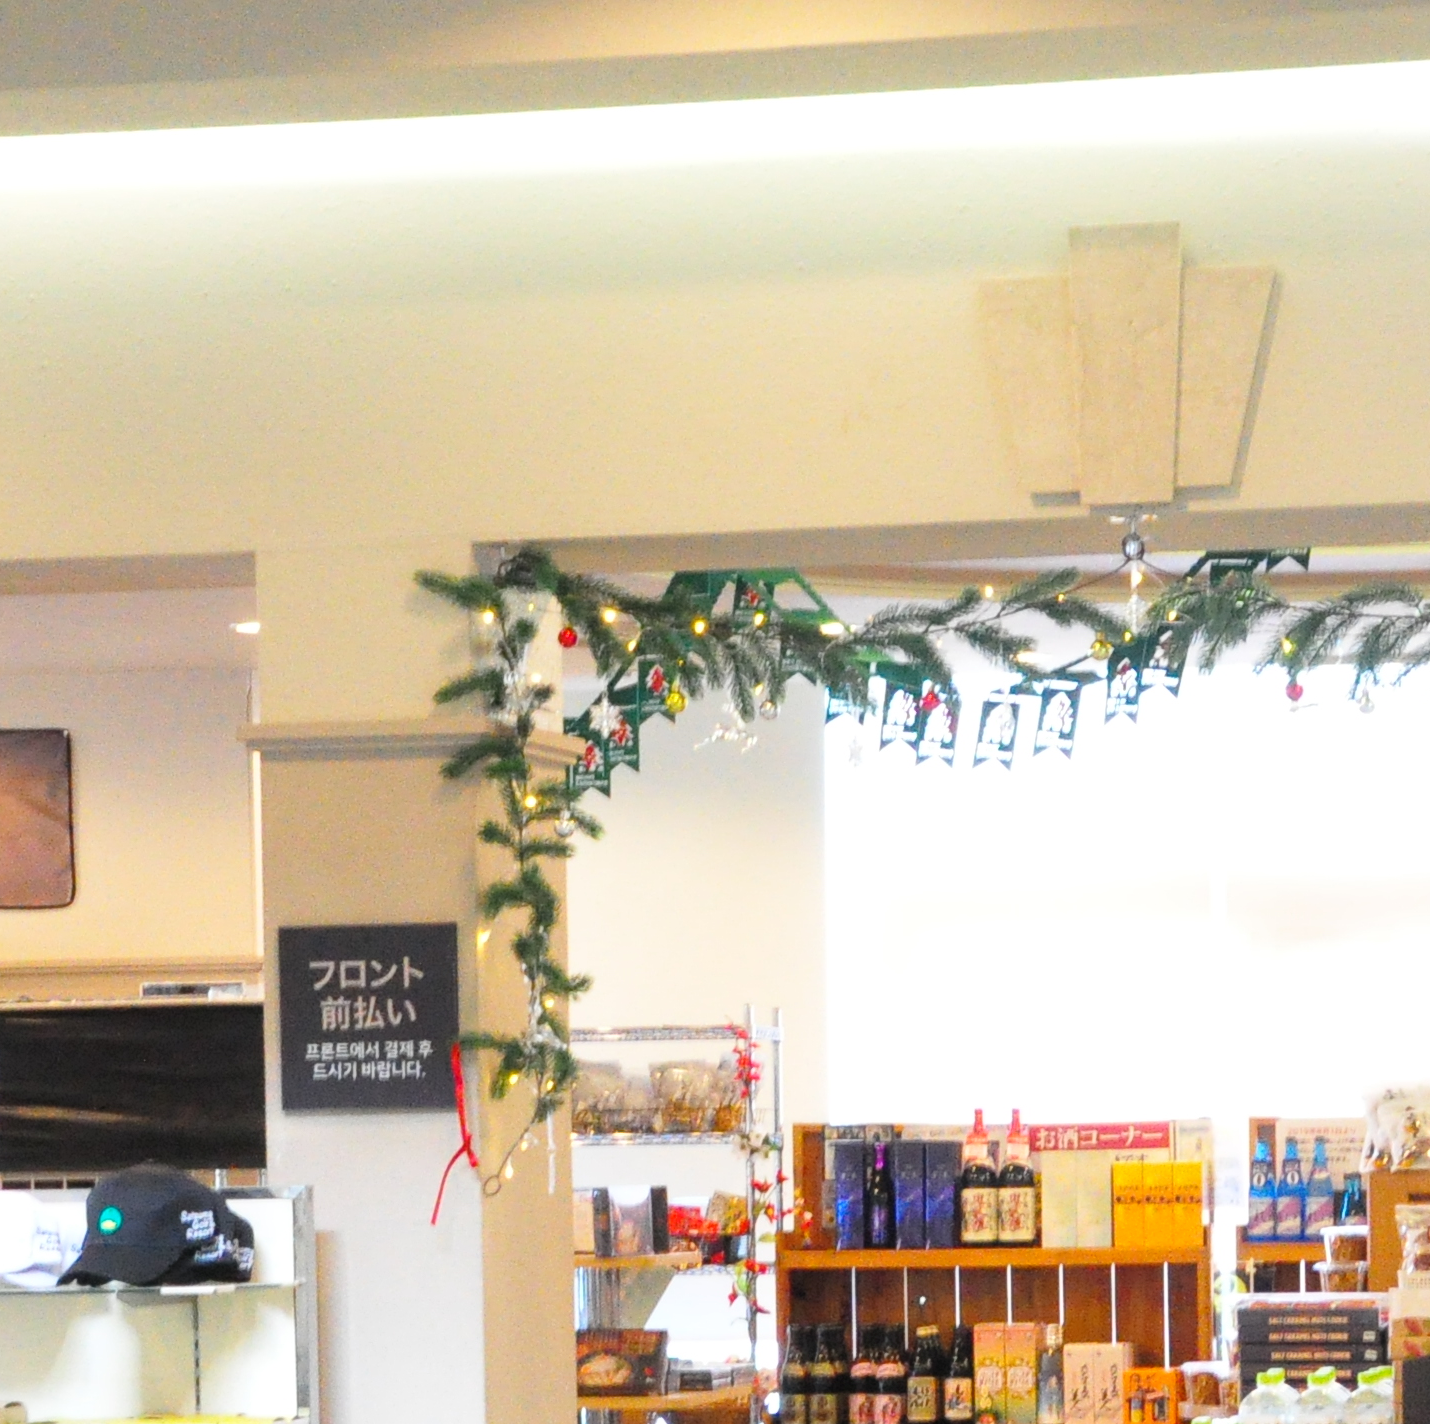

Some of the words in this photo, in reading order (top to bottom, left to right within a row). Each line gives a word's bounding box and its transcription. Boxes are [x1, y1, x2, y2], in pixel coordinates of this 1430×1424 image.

[309, 956, 424, 991] フロント
[320, 995, 417, 1032] 前払い
[1035, 1125, 1163, 1149] お酒コーナー
